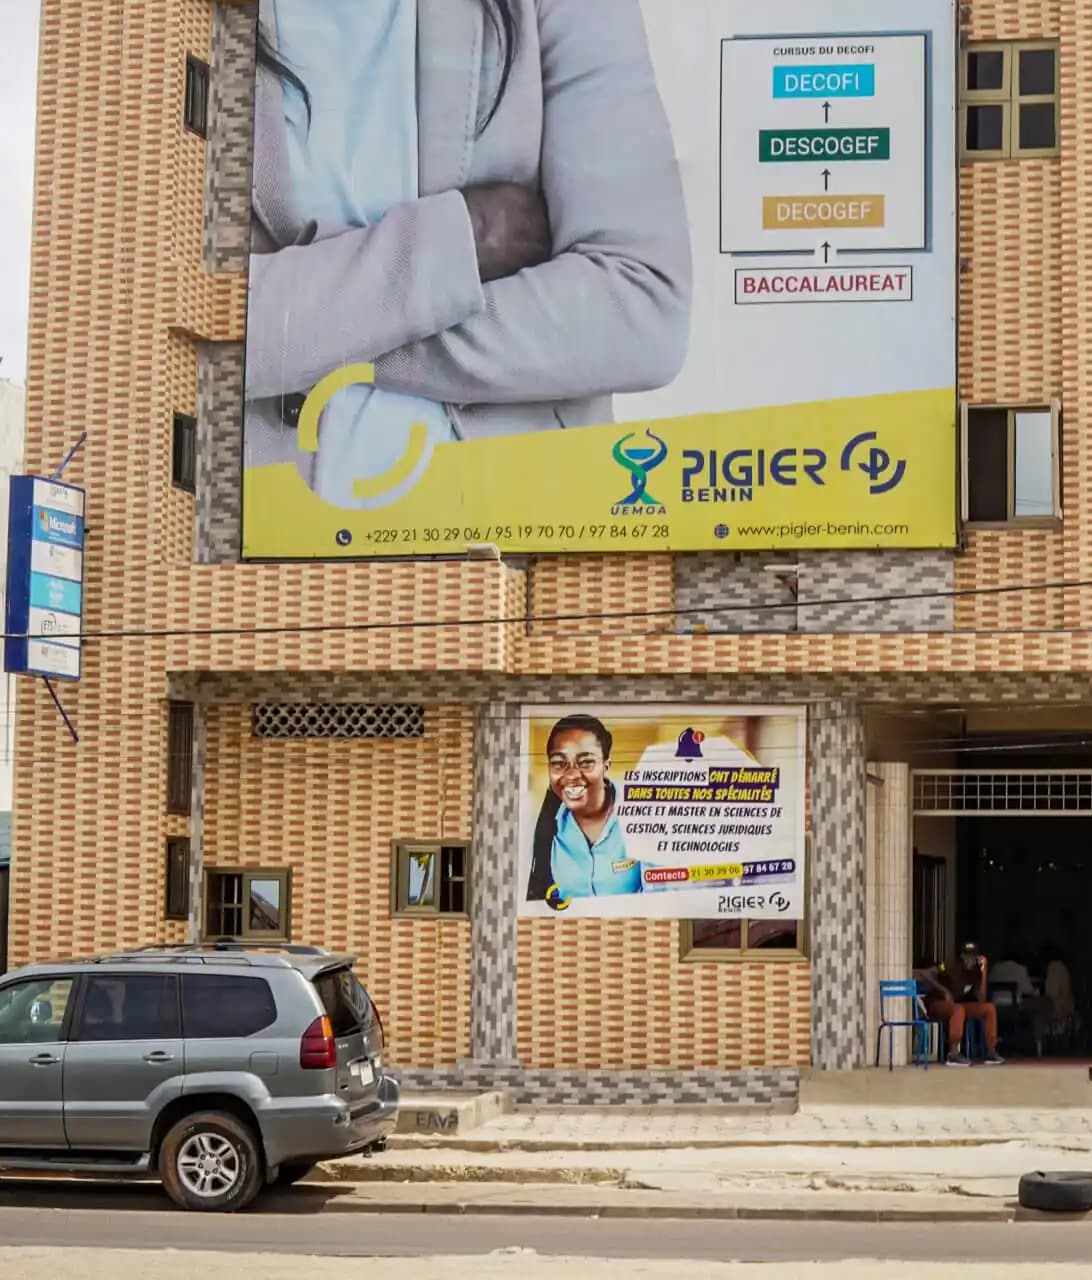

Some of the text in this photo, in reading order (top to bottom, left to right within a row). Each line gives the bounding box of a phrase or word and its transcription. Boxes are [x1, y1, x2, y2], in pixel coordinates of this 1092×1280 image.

[772, 45, 875, 56] CURSUS DU DECOFI
[784, 72, 860, 92] DECOFI
[770, 135, 879, 156] DESCOGEF
[776, 201, 872, 221] DECOGEF
[743, 273, 908, 294] BACCALAUREAT
[682, 448, 828, 488] PIGIER
[682, 487, 753, 503] BENIN
[610, 505, 667, 516] UEMOA
[365, 524, 669, 543] +229 21 30 29 06 / 95 19 70 70 / 97 84 67 28
[737, 520, 909, 537] www.pigier-benin.com
[624, 768, 777, 783] LES INSCRIPTIONS ONT DÉMARRÉ
[627, 785, 772, 801] DANS TOUTES NOS SPÉCIALITÉS
[617, 806, 783, 818] LICENCE ET MASTER EN SCIENCES DE
[626, 823, 772, 836] GESTION, SCIENCES JURIDIQUES
[657, 841, 740, 852] ET TECHNOLOGIES
[645, 871, 686, 881] Contacts
[704, 868, 714, 876] 30
[744, 865, 754, 874] 97
[756, 864, 767, 873] 84
[769, 862, 779, 871] 67
[782, 861, 792, 871] 28
[718, 895, 765, 909] PIGIER
